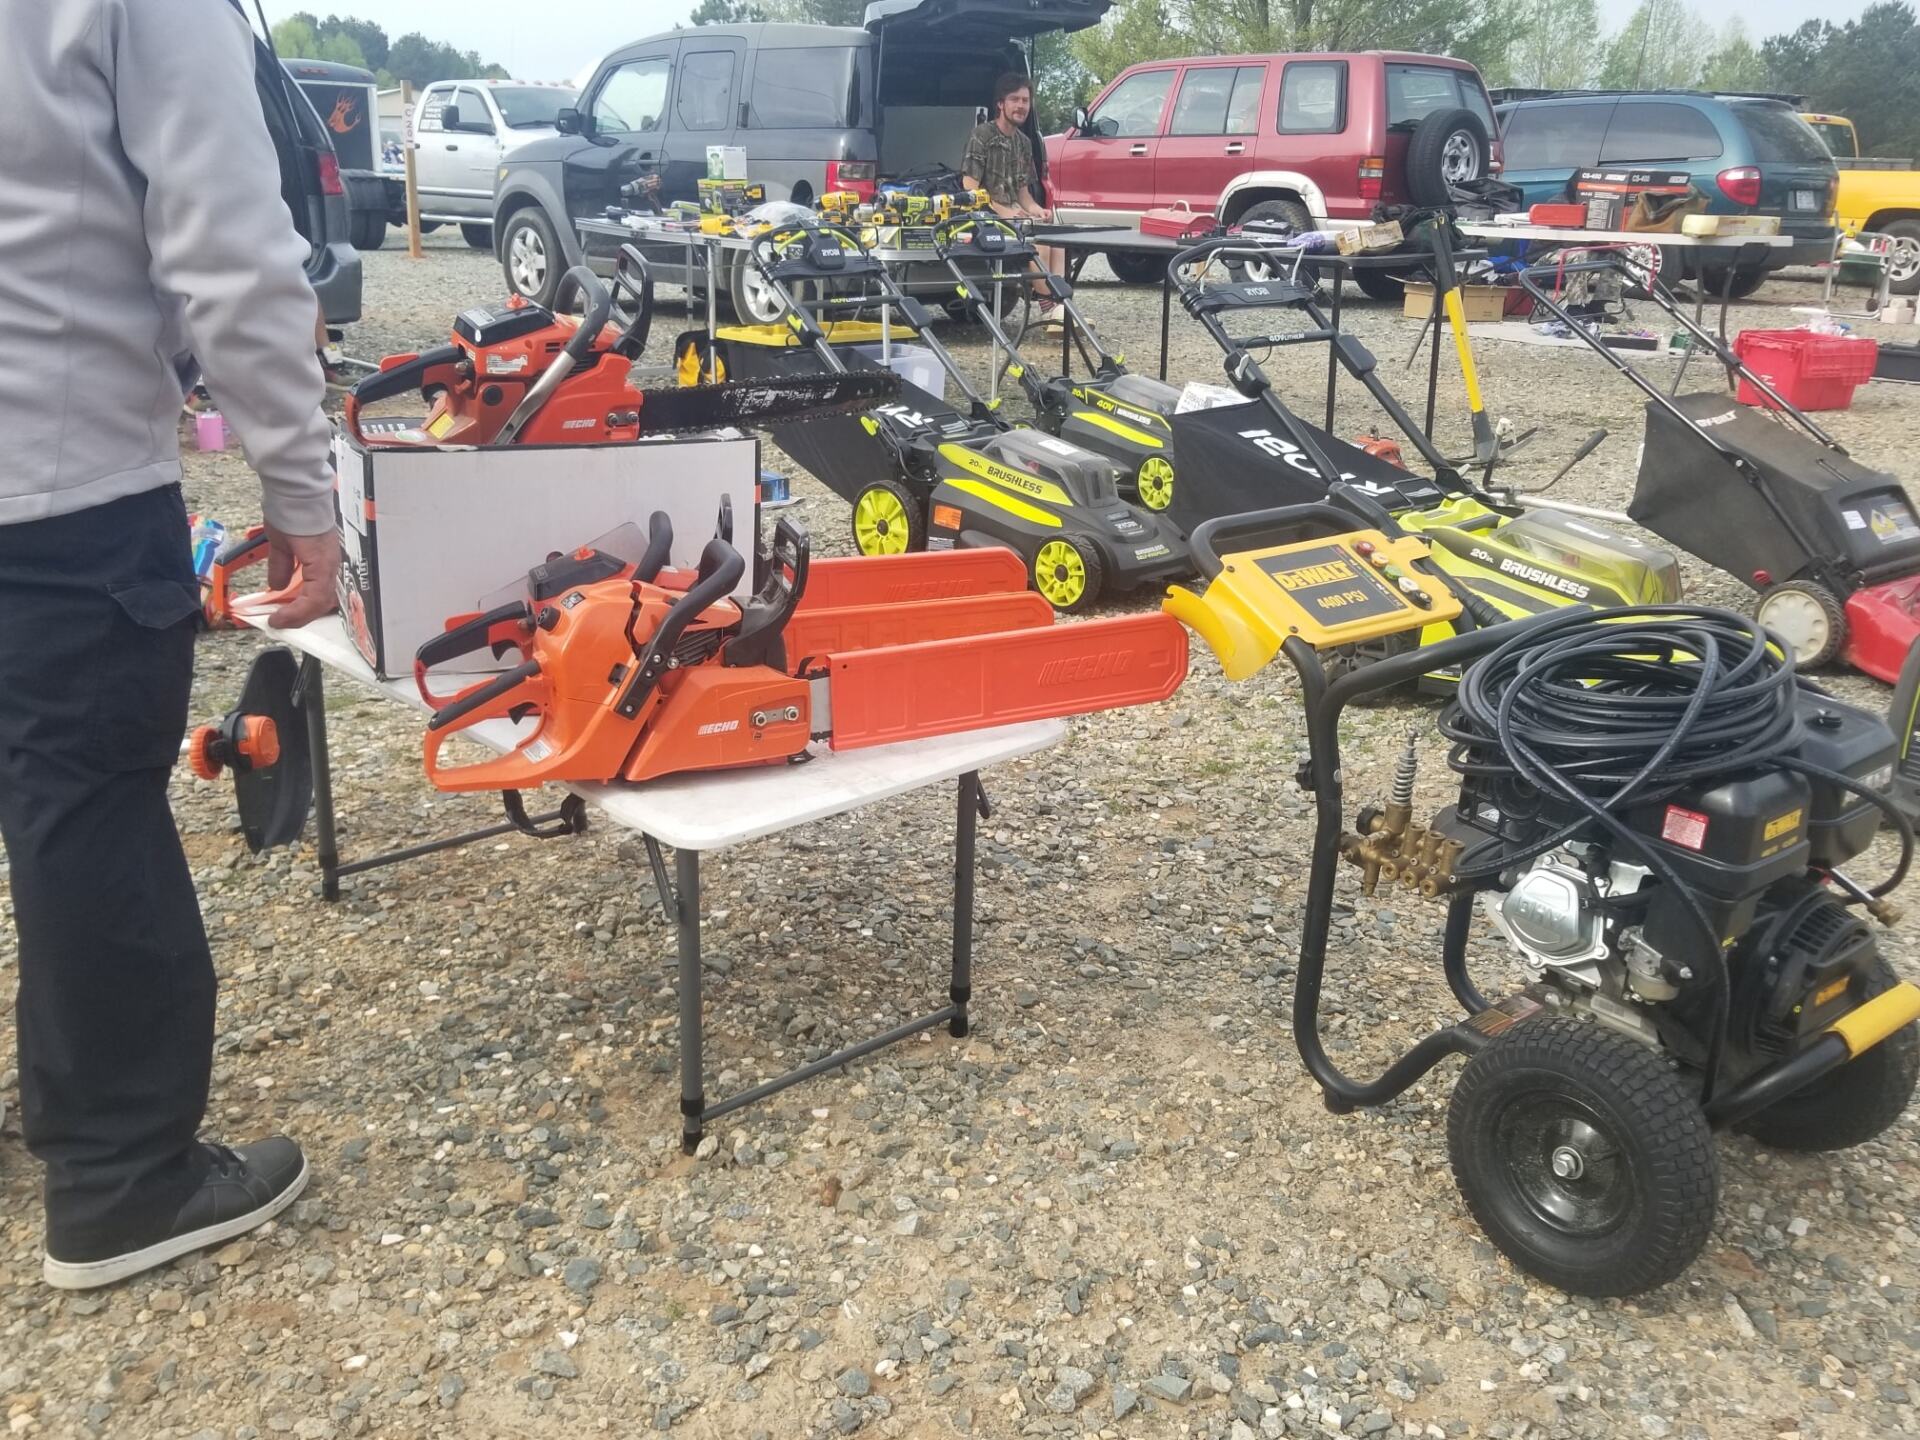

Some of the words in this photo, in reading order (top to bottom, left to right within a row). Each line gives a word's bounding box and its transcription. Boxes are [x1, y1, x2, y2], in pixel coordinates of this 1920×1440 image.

[1243, 287, 1271, 297] RYOBI
[987, 465, 1044, 495] BRUSHLESS
[1499, 557, 1591, 599] BRUSHLESS
[1316, 593, 1346, 609] 4400
[1349, 589, 1370, 605] PSI
[1056, 650, 1136, 683] ECHO
[705, 719, 740, 734] ECHO
